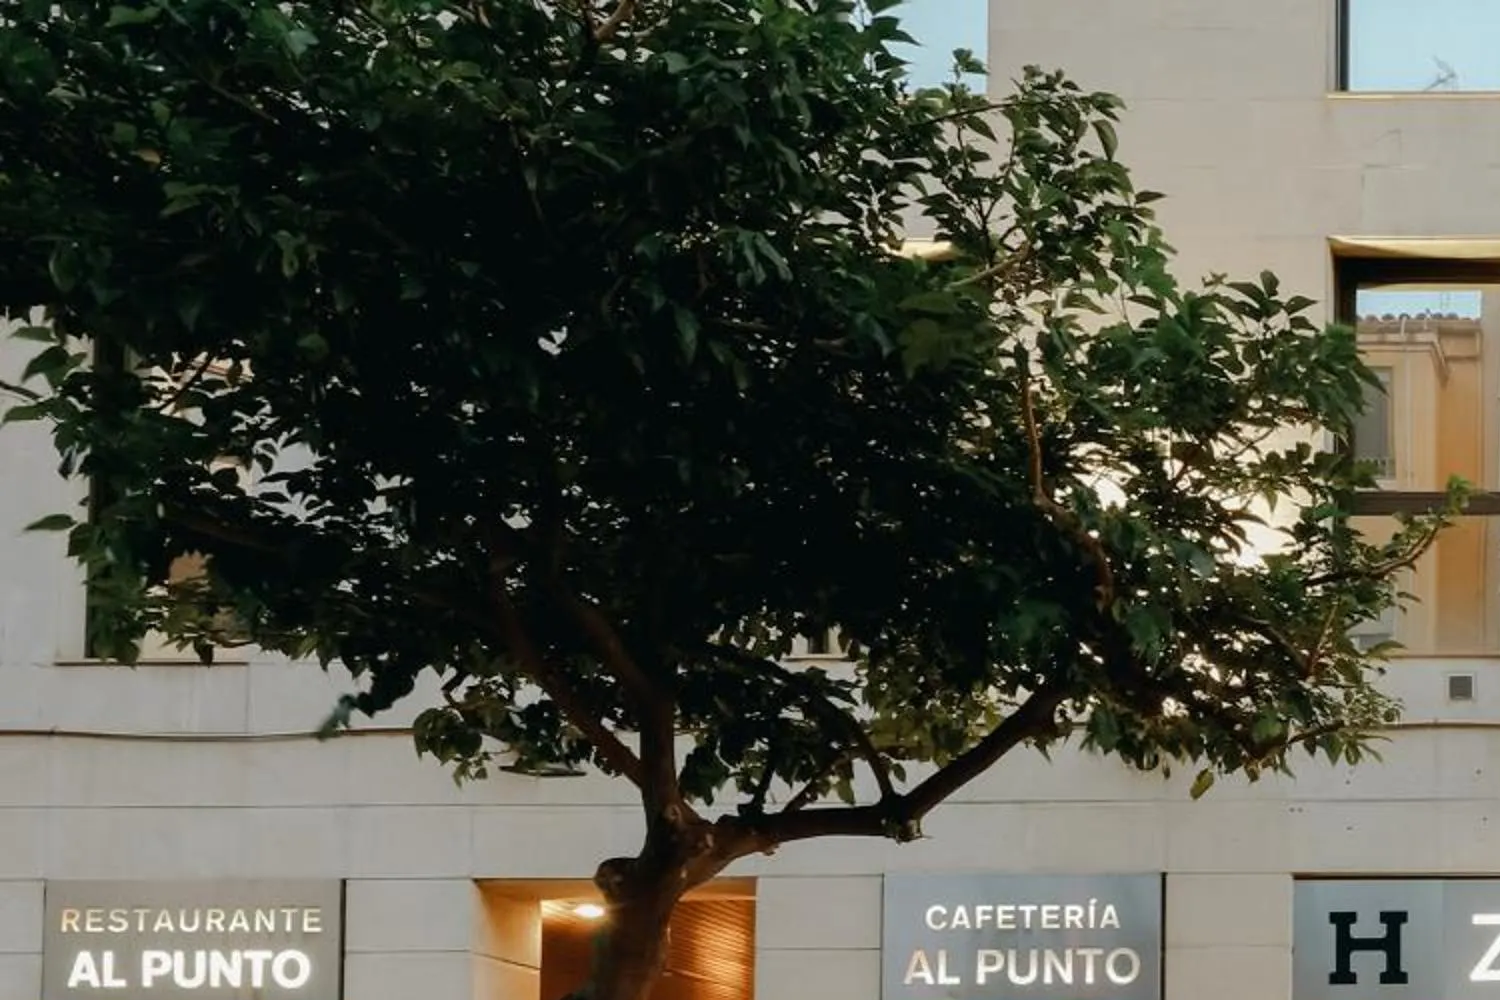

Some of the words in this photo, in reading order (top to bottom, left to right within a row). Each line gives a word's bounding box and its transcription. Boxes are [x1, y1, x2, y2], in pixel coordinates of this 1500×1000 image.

[60, 908, 323, 933] RESTAURANTE
[925, 898, 1121, 930] CAFETERÍA
[903, 949, 961, 985] AL
[975, 947, 1141, 986] PUNTO
[1328, 911, 1409, 984] H
[67, 950, 127, 988] AL
[142, 949, 312, 989] PUNTO
